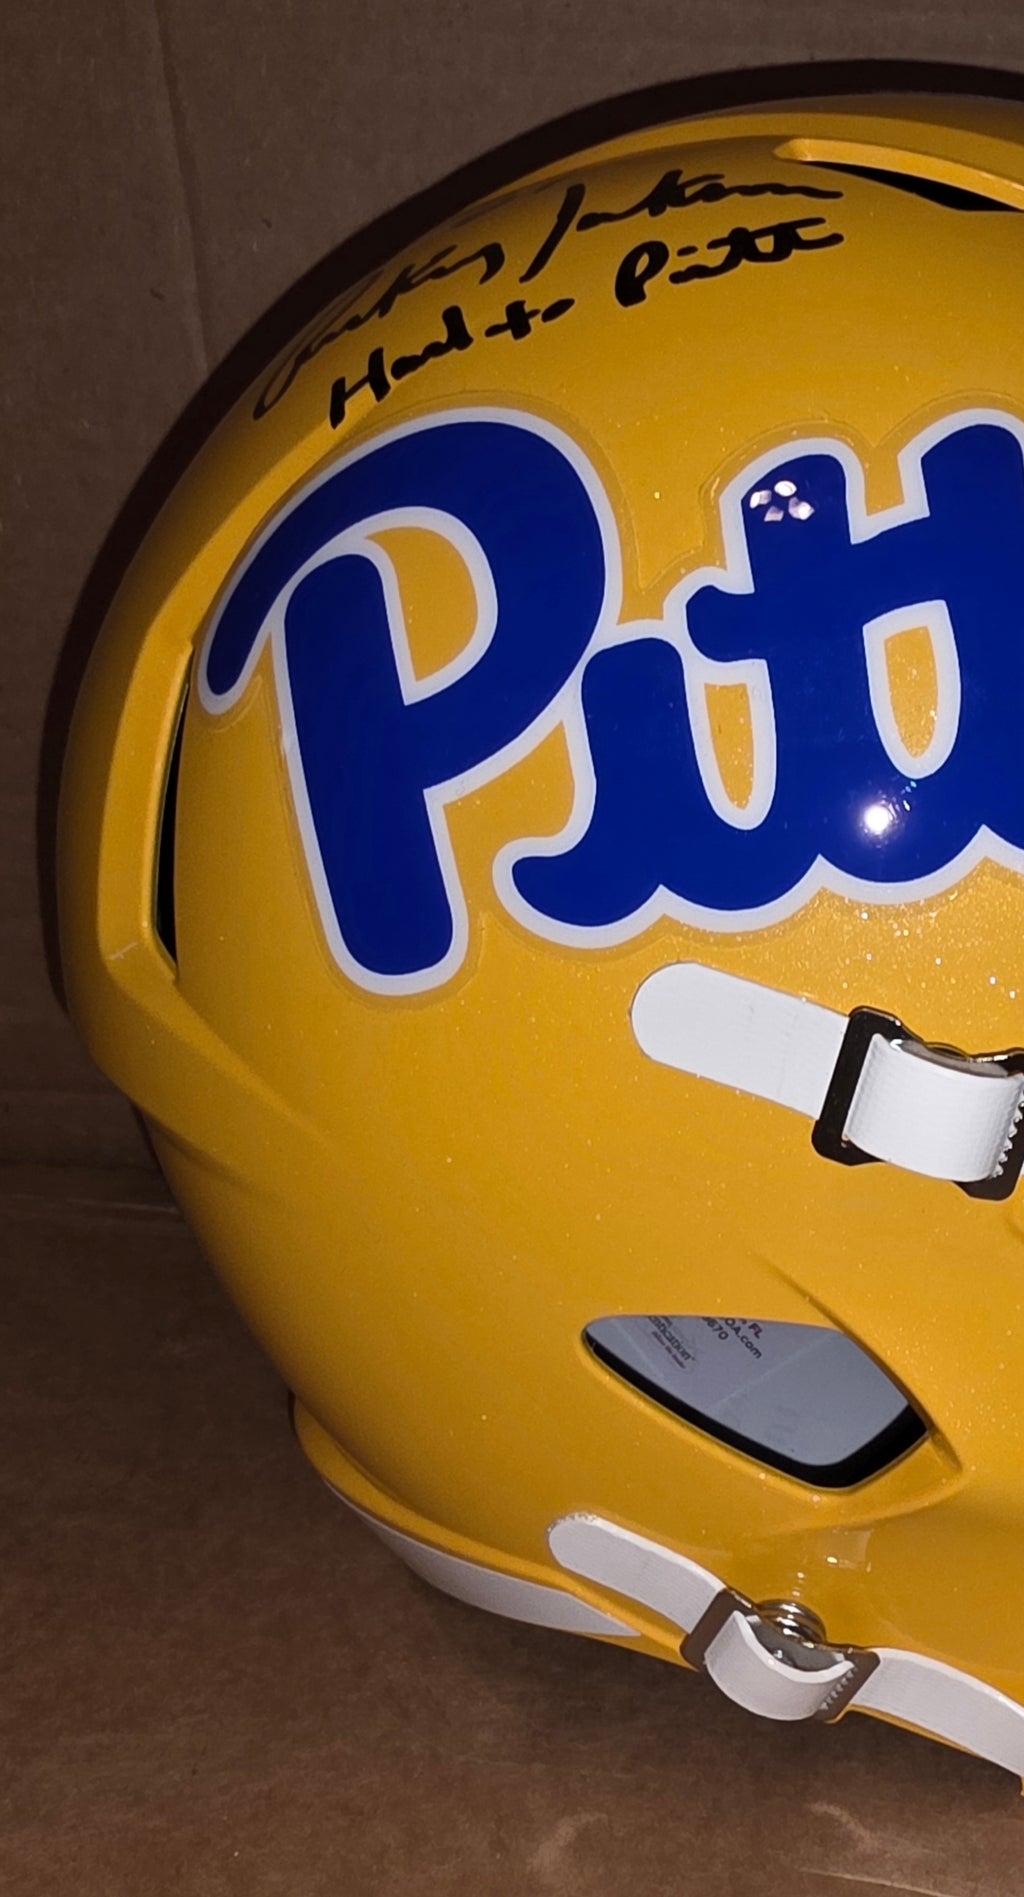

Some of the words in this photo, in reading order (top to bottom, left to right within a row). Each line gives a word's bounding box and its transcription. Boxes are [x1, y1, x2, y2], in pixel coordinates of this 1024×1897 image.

[484, 297, 576, 341] to
[613, 216, 845, 307] Pitt
[723, 1317, 762, 1359] OA.com
[748, 1322, 763, 1340] FL
